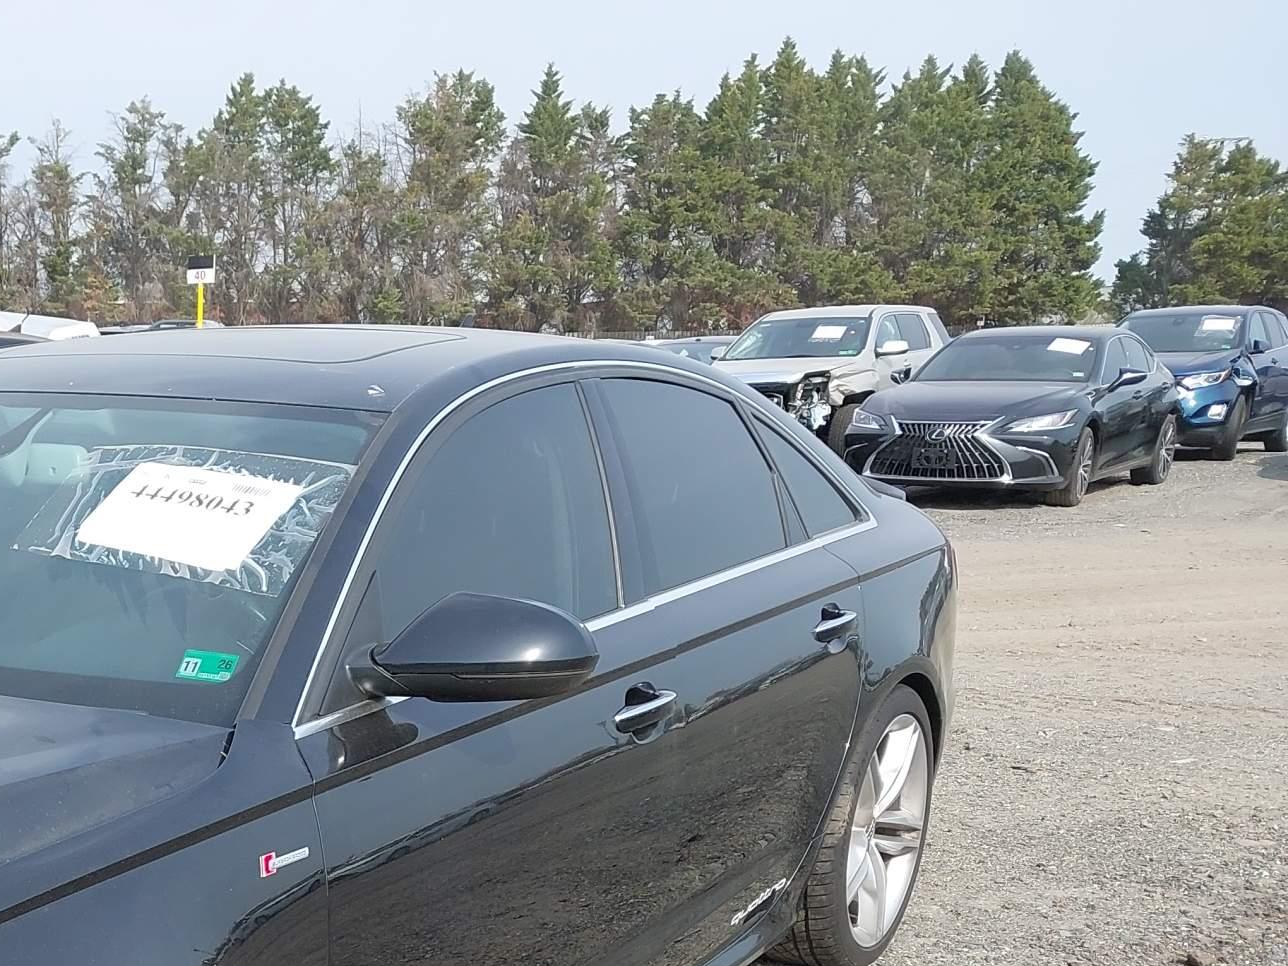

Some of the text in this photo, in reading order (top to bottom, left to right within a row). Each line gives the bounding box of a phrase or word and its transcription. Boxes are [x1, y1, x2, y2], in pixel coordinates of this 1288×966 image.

[130, 484, 255, 516] 44498043
[183, 659, 233, 673] 11 26
